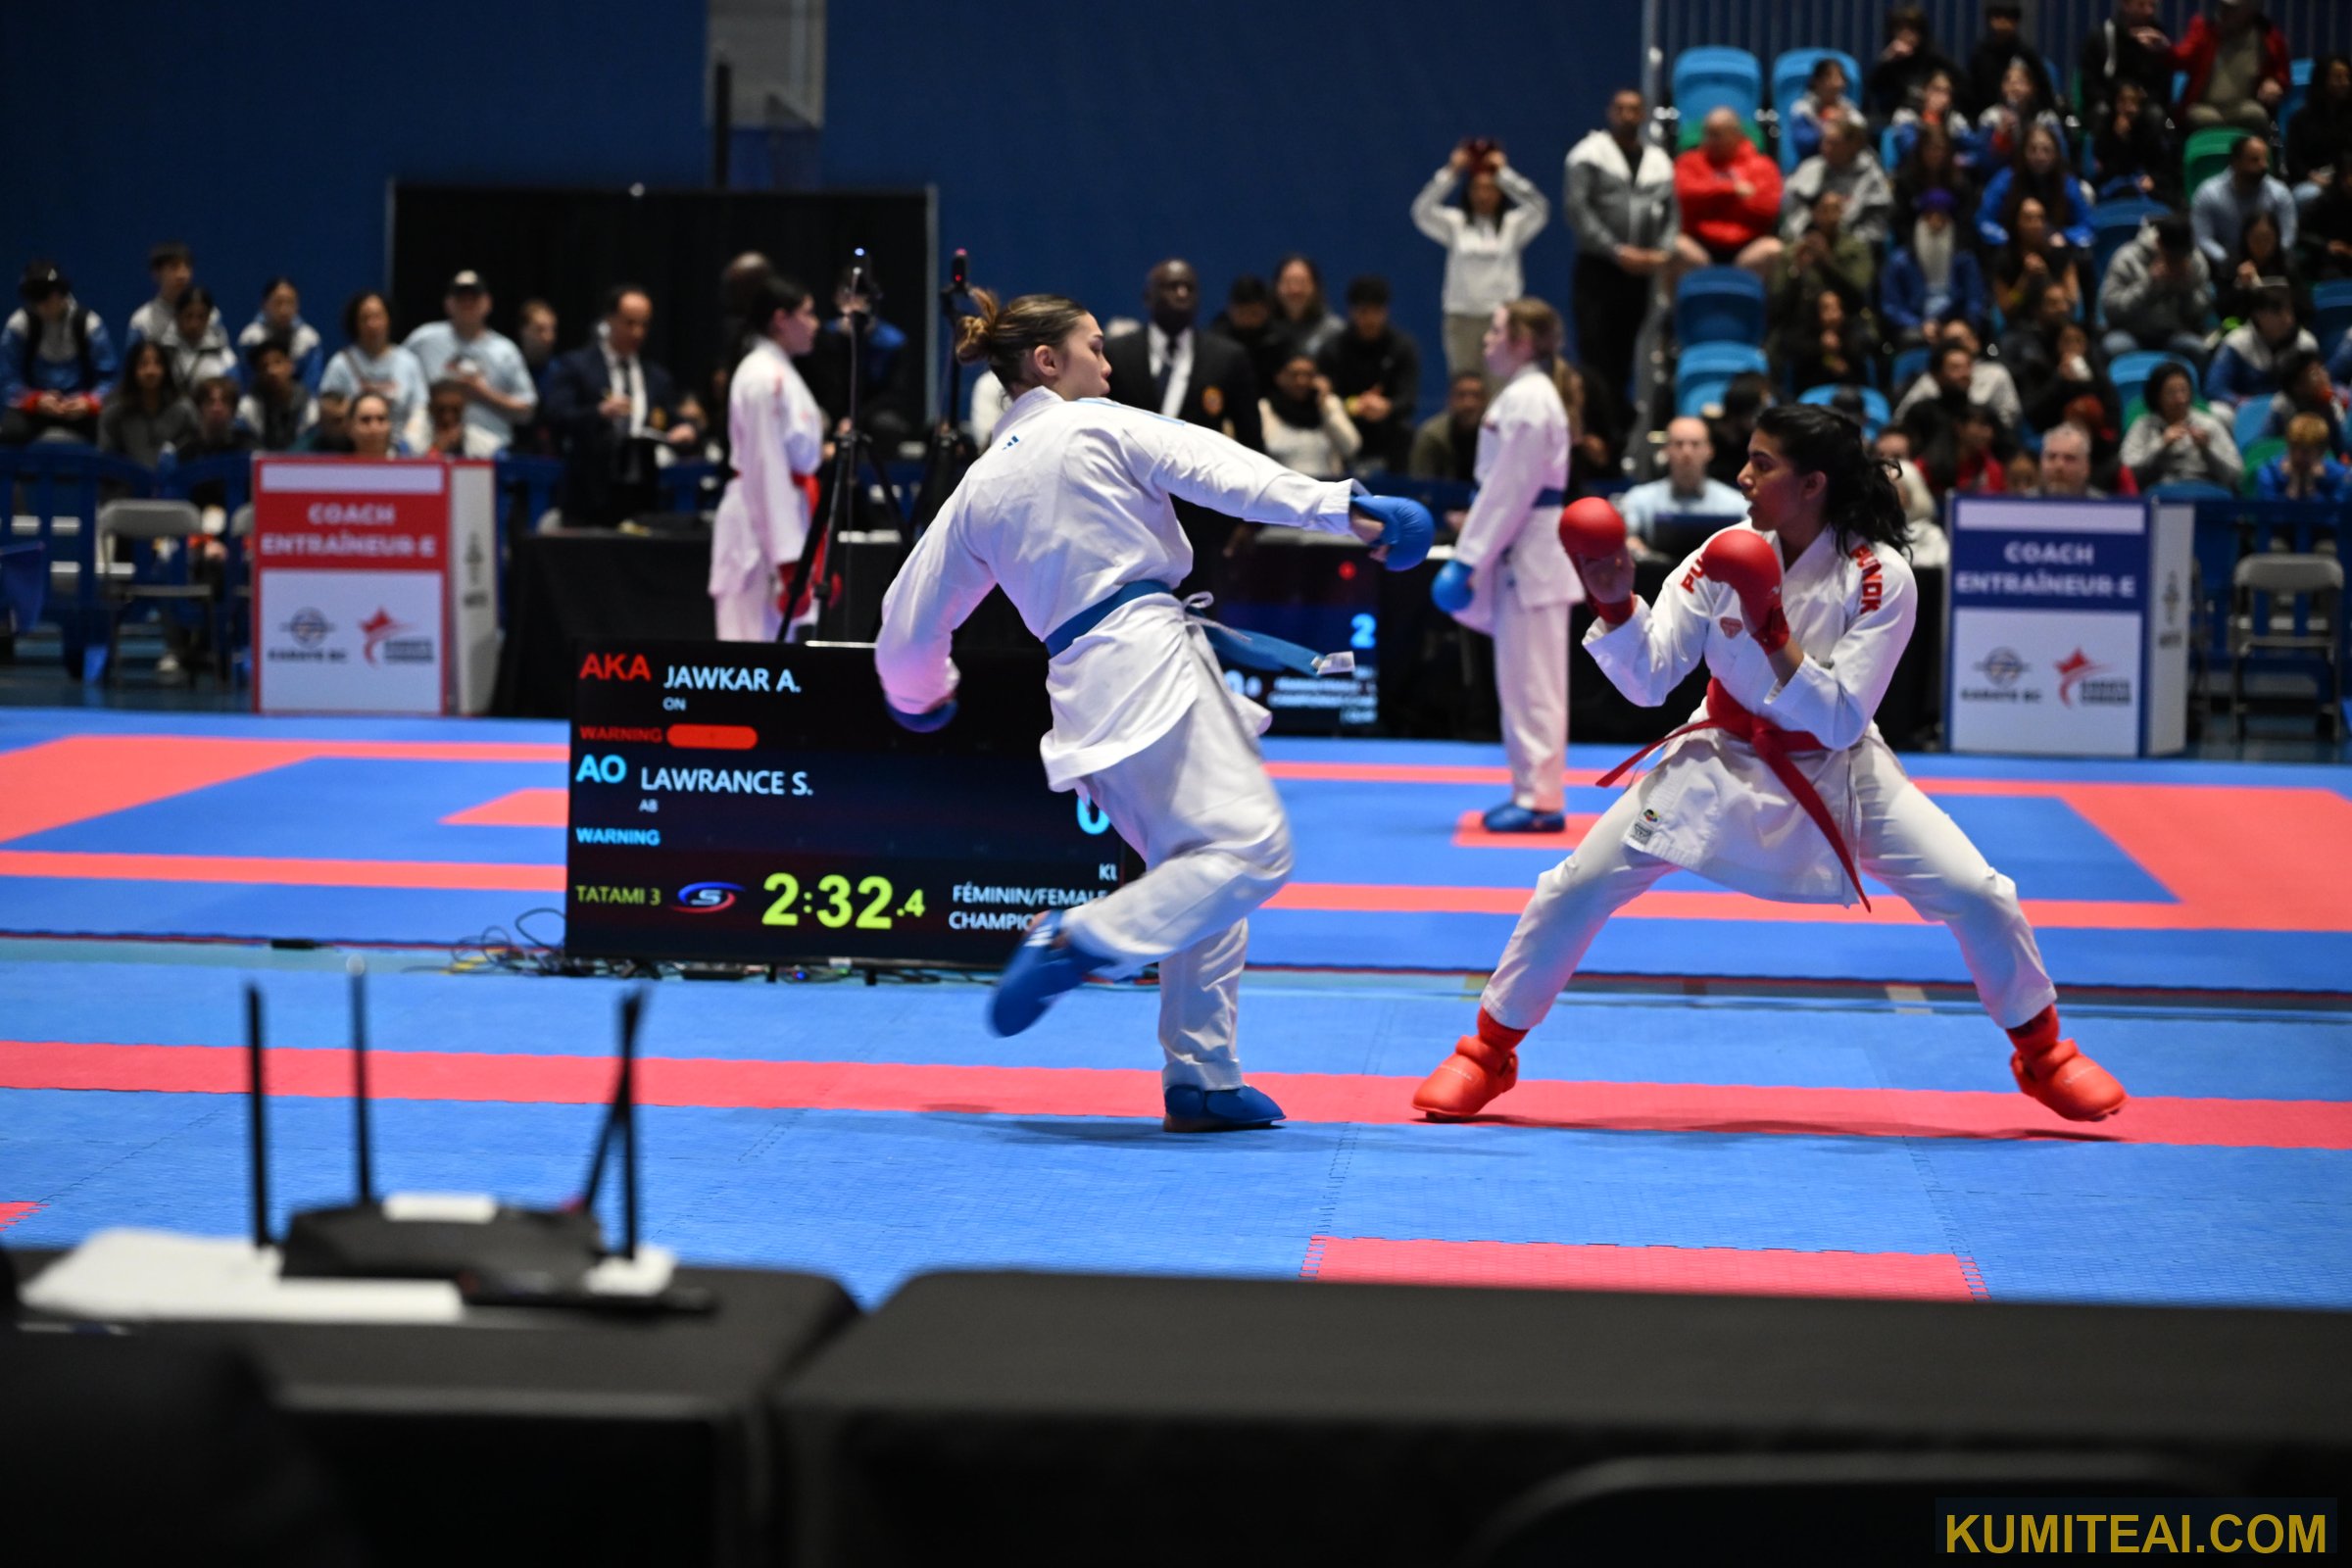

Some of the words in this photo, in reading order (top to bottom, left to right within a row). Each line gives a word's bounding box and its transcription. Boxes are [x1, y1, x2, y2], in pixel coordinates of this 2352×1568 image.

[308, 503, 396, 525] COACH
[2004, 541, 2095, 565] COACH
[1350, 612, 1377, 649] 2
[579, 653, 652, 681] AKA
[663, 665, 770, 692] JAWKAR
[775, 669, 802, 692] A.
[662, 697, 686, 710] ON
[579, 725, 663, 743] WARNING
[574, 754, 627, 783] AO
[641, 767, 786, 795] LAWRANCE
[791, 771, 814, 796] S.
[638, 799, 659, 813] AB
[575, 827, 662, 846] WARNING
[575, 885, 646, 905] TATAMI
[650, 888, 662, 906] 3
[761, 872, 926, 930] 2:32.4
